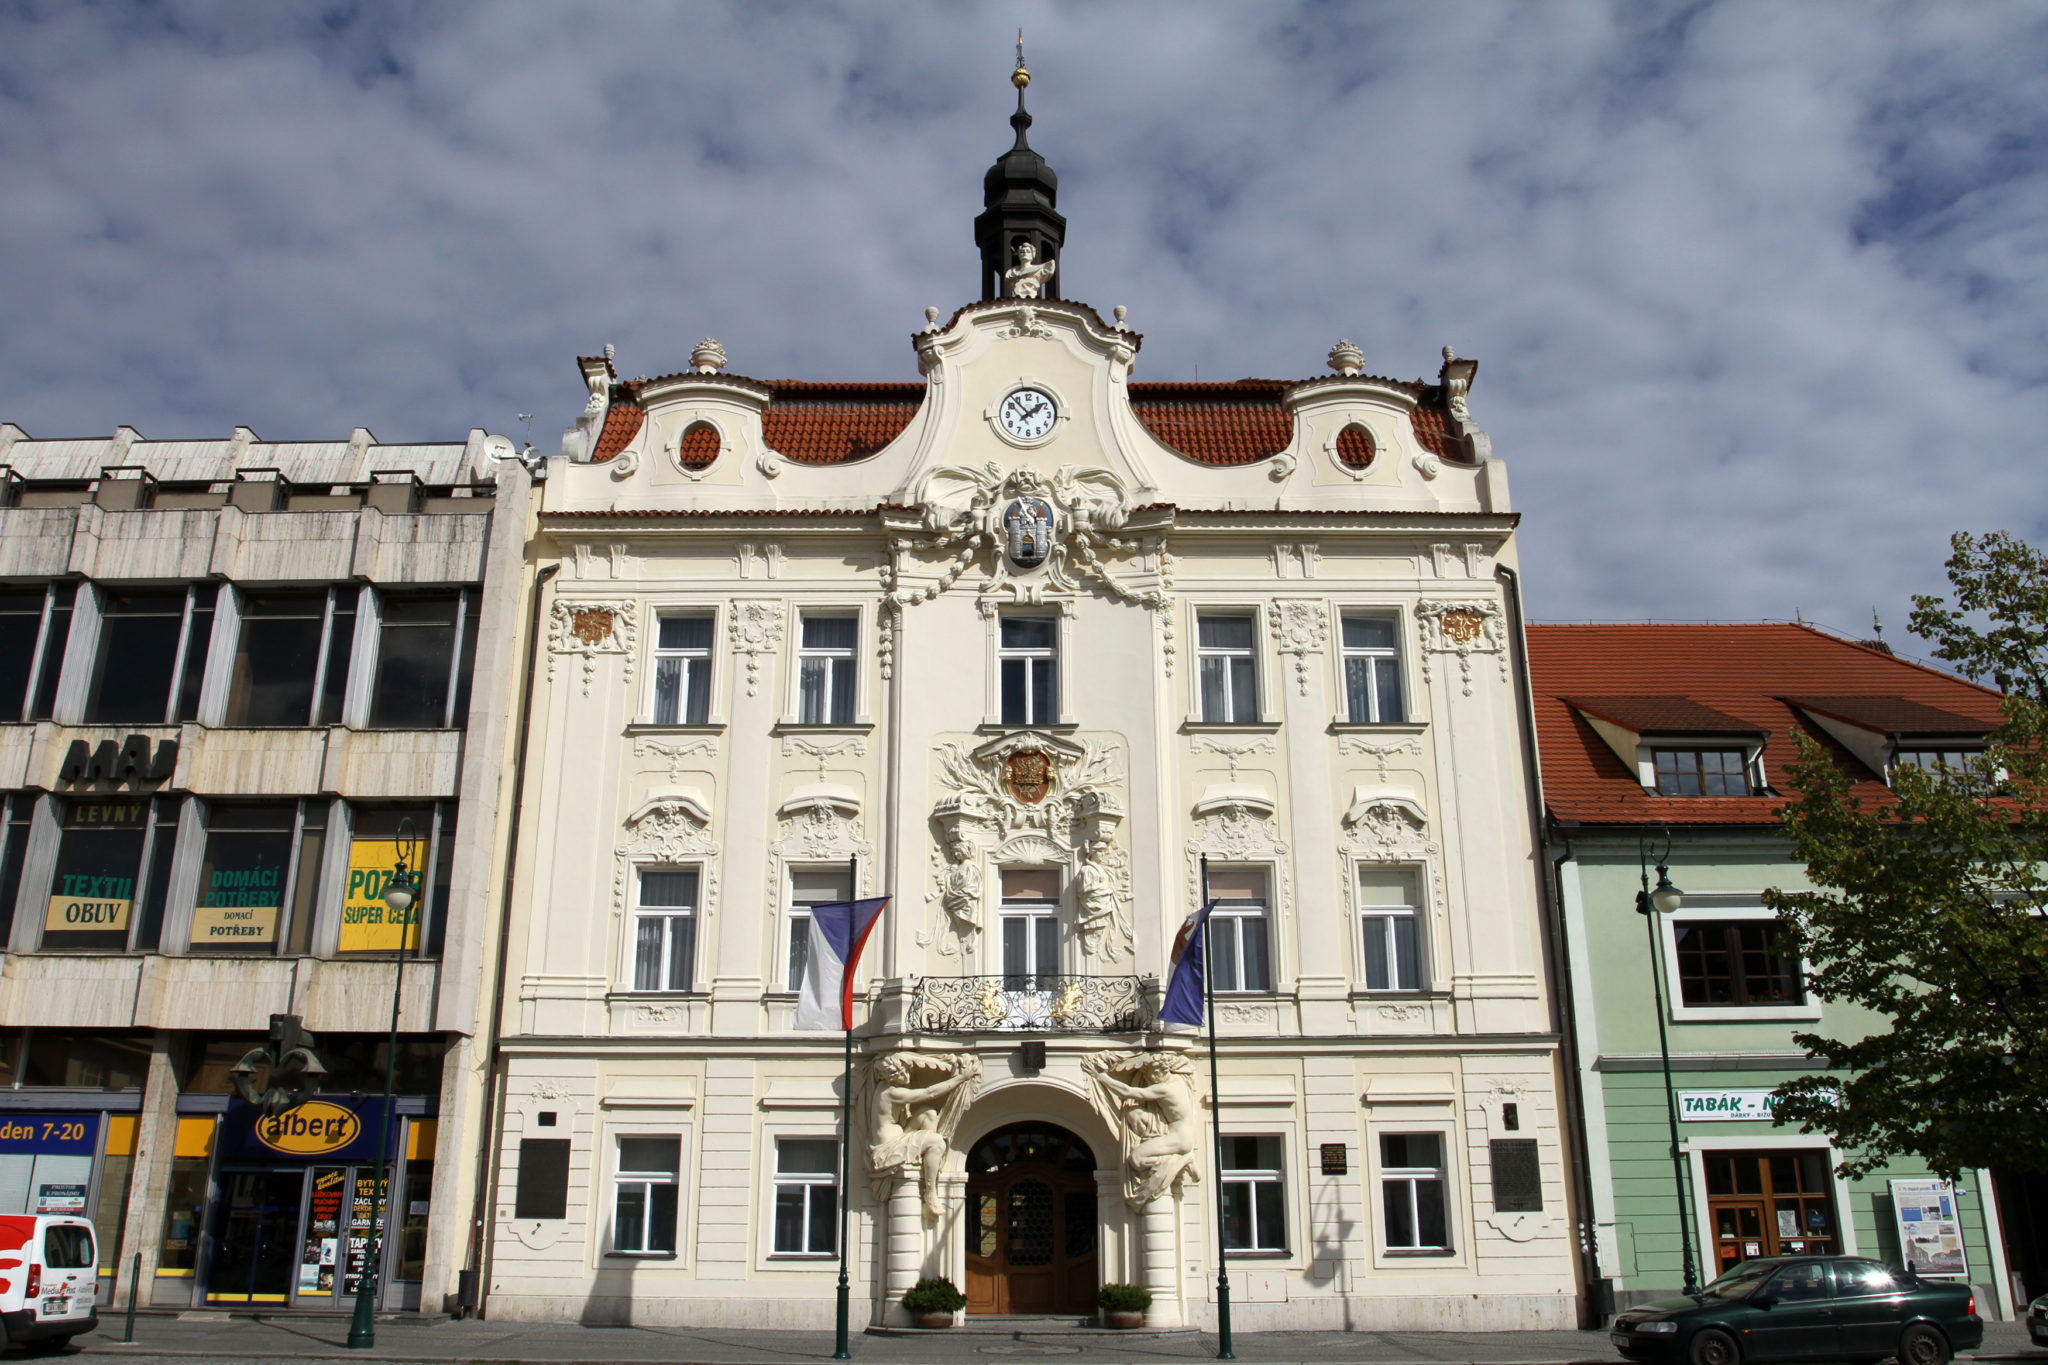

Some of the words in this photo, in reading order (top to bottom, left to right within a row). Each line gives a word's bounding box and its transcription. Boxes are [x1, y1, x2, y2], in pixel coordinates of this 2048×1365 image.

[1025, 393, 1032, 401] 12
[1005, 411, 1011, 419] 9
[1046, 411, 1052, 419] 3
[1008, 420, 1013, 428] 8
[1043, 420, 1048, 429] 4
[1016, 426, 1022, 434] 7
[1025, 429, 1031, 437] 6
[1036, 427, 1041, 435] 5
[75, 802, 142, 823] LEVNÝ
[211, 866, 280, 888] DOMÁCÍ
[62, 874, 133, 900] TEXTIL
[348, 869, 423, 900] POZR
[203, 888, 280, 908] POTŘEBY
[65, 902, 121, 924] OBUV
[344, 906, 383, 924] SUPER
[209, 924, 264, 936] POTŘEBY
[1684, 1093, 1742, 1112] TABÁK
[266, 1113, 348, 1137] albert
[0, 1121, 34, 1140] den
[42, 1122, 85, 1141] 7-20
[356, 1178, 389, 1188] BYTÝ
[359, 1188, 385, 1196] TEXL
[354, 1197, 387, 1206] ZÁCLNY
[351, 1218, 385, 1226] GARNŽE
[350, 1237, 383, 1249] TAPY
